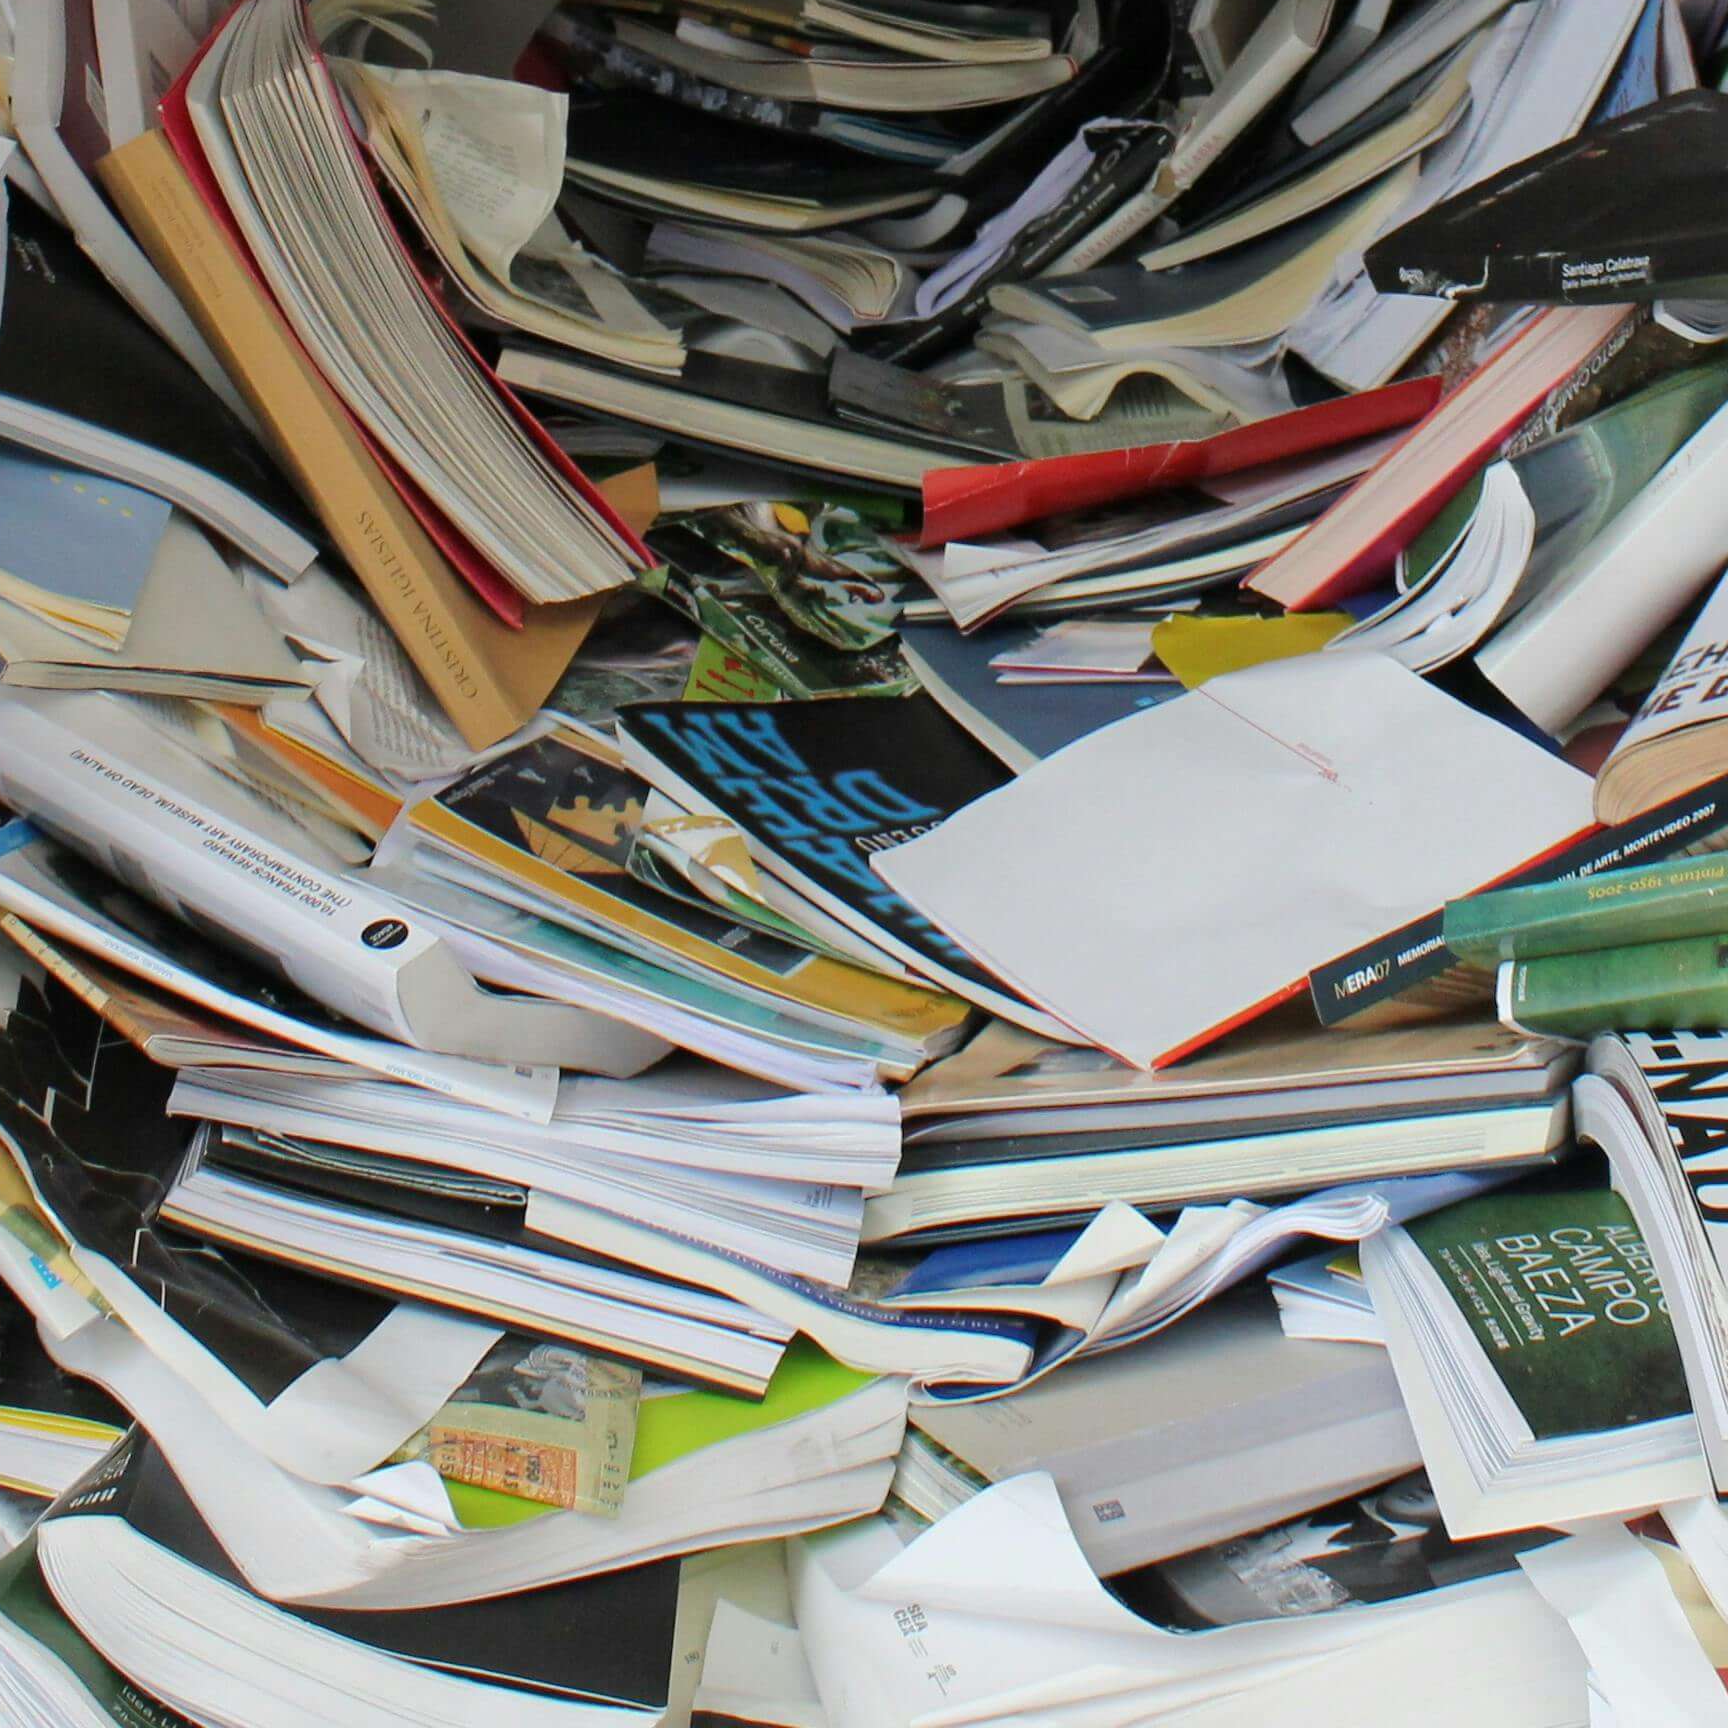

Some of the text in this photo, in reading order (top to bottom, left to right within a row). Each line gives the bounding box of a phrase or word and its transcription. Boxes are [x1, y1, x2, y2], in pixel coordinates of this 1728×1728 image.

[1562, 255, 1650, 278] Santiago Calatrava
[355, 510, 480, 702] CRISTINA IGLESIAS
[69, 747, 106, 773] ALIVE)
[104, 767, 121, 781] OR
[120, 775, 156, 801] DEAD
[203, 821, 229, 840] ART
[226, 828, 323, 893] CONTEMPORARY
[202, 838, 302, 902] FRANCS REWARD
[1332, 958, 1393, 1001] MERA07
[1578, 861, 1595, 877] DE
[1622, 812, 1692, 860] MONTEVIDEO
[1690, 802, 1717, 824] 2007
[1495, 1231, 1597, 1338] BAEZA
[1547, 1226, 1652, 1327] CAMPO
